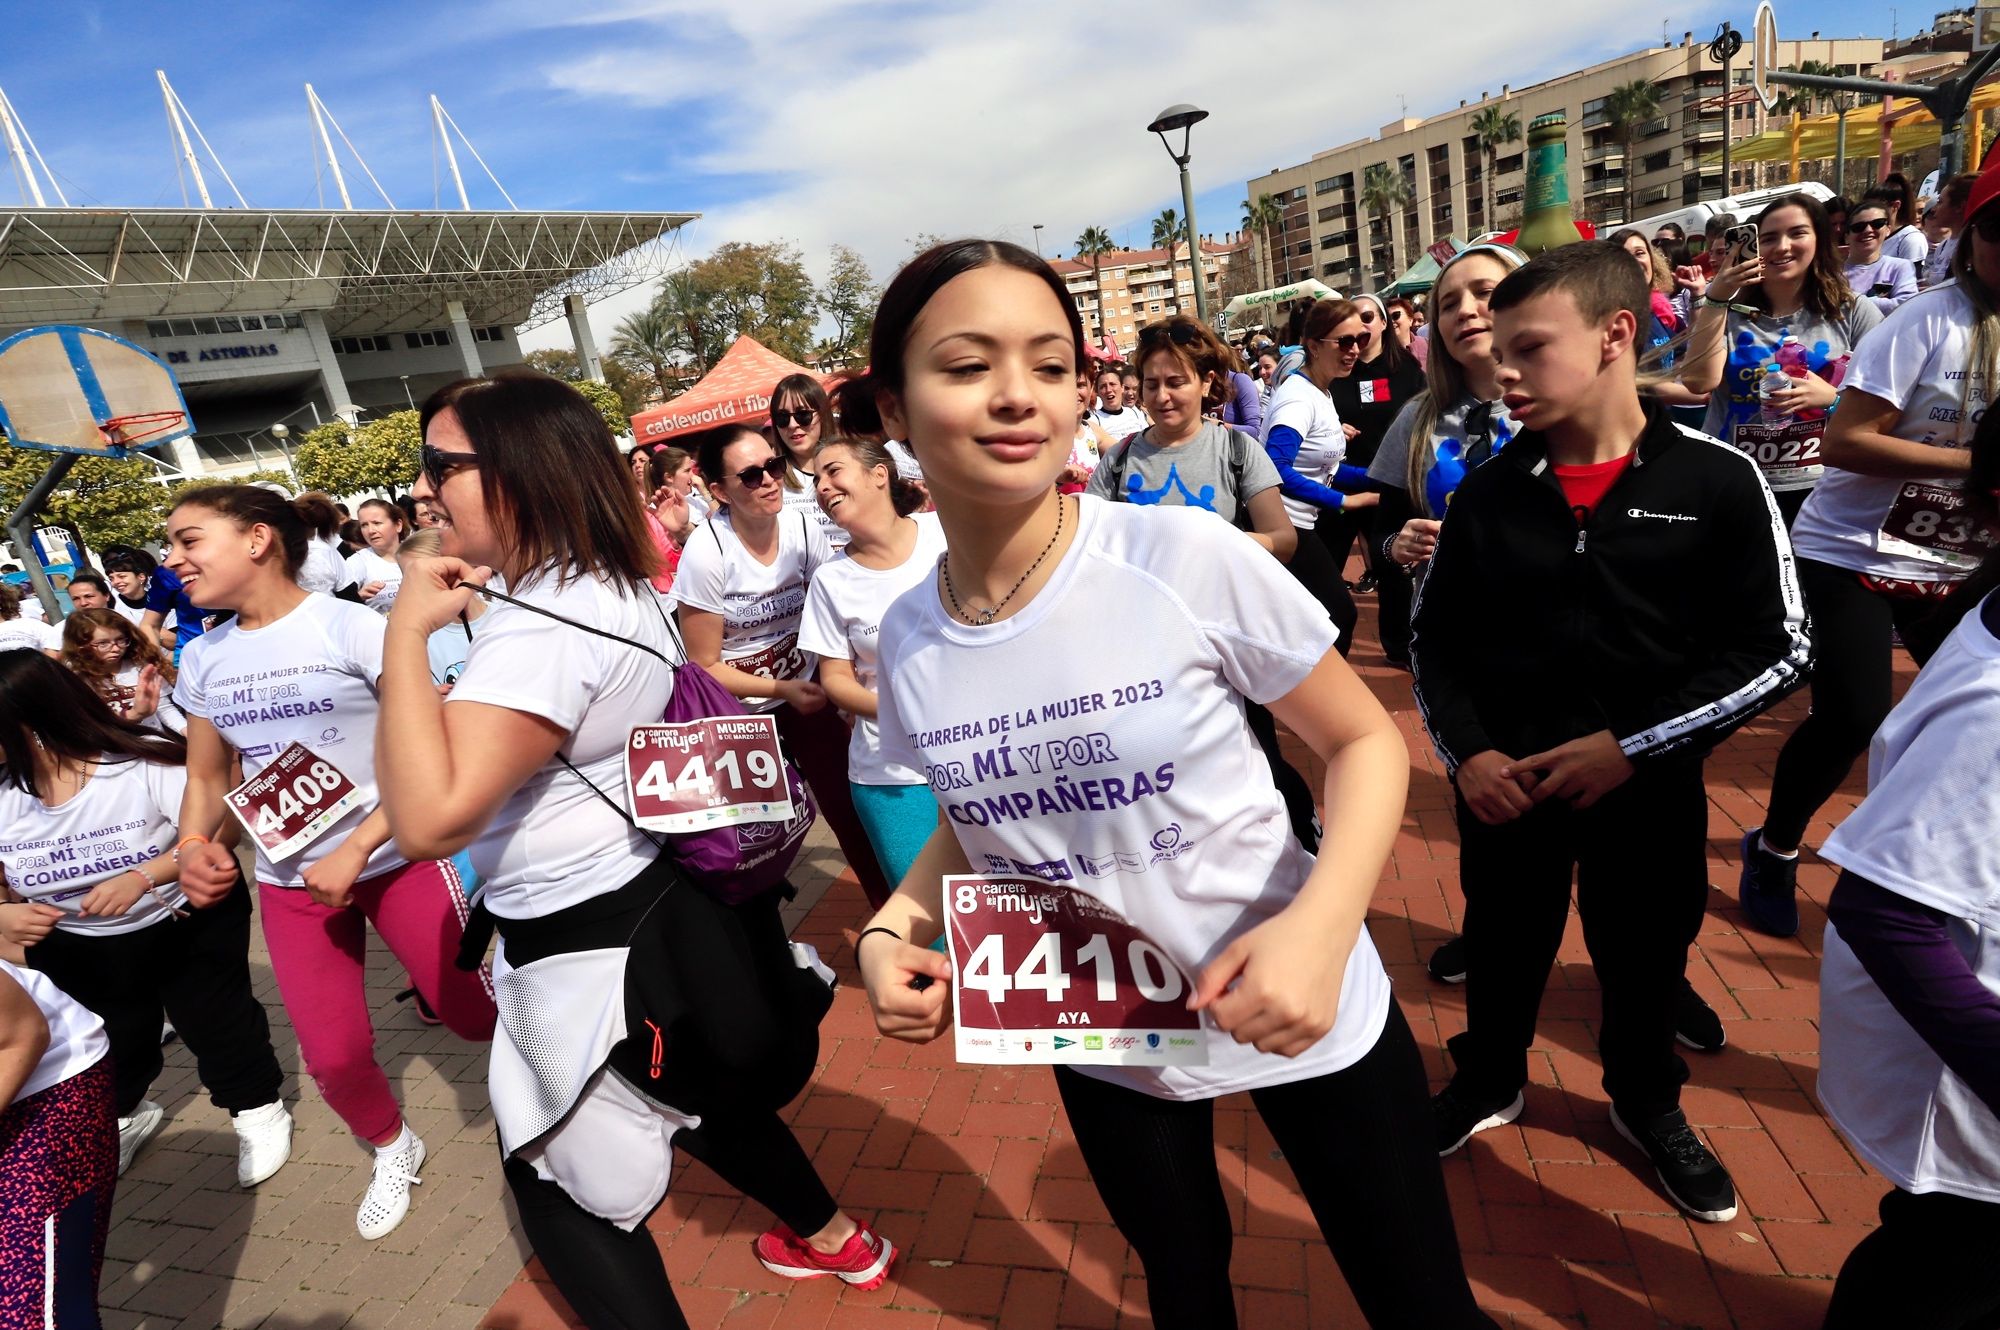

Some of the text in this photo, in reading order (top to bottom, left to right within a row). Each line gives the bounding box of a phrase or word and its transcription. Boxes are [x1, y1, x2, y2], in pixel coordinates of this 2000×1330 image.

[1272, 287, 1299, 302] Inglés
[168, 344, 279, 363] DE ASTURIAS
[645, 400, 736, 436] cableworld
[1790, 422, 1822, 432] MURCIA
[1753, 430, 1783, 441] mujer
[1738, 437, 1821, 463] 2022
[1628, 509, 1698, 523] Champion
[1782, 553, 1794, 605] Champion
[736, 591, 804, 617] POR MÍ Y POR
[863, 625, 878, 636] VIII
[244, 674, 255, 683] DE
[257, 670, 268, 681] LA
[270, 667, 299, 679] MUJER
[302, 663, 328, 674] 2023
[743, 653, 769, 667] mujer
[233, 683, 255, 705] MÍ
[257, 687, 268, 701] Y
[270, 684, 302, 700] POR
[213, 698, 334, 729] COMPAÑERAS
[920, 721, 984, 748] CARRERA
[988, 714, 1011, 735] DE
[1015, 708, 1038, 729] LA
[1042, 693, 1108, 723] MUJER
[1111, 679, 1164, 708] 2023
[1666, 706, 1722, 731] Champion
[648, 728, 679, 737] carrera
[716, 722, 768, 735] MURCIA
[658, 730, 705, 754] mujer
[925, 732, 1120, 793] POR MÍ Y POR
[253, 771, 280, 797] mujer
[636, 750, 778, 802] 4419
[256, 761, 341, 836] 4408
[706, 796, 729, 807] BEA
[948, 762, 1175, 827] COMPAÑERAS
[16, 840, 56, 851] CARRERA
[58, 835, 72, 845] DE
[74, 833, 87, 841] LA
[89, 825, 122, 838] MUJER
[125, 819, 147, 831] 2023
[17, 839, 128, 869] POR MÍ Y POR
[24, 845, 160, 887] COMPAÑERAS
[982, 883, 1027, 894] carrera
[997, 893, 1060, 925] mujer
[962, 932, 1183, 1003] 4410
[1057, 1012, 1091, 1025] AYA
